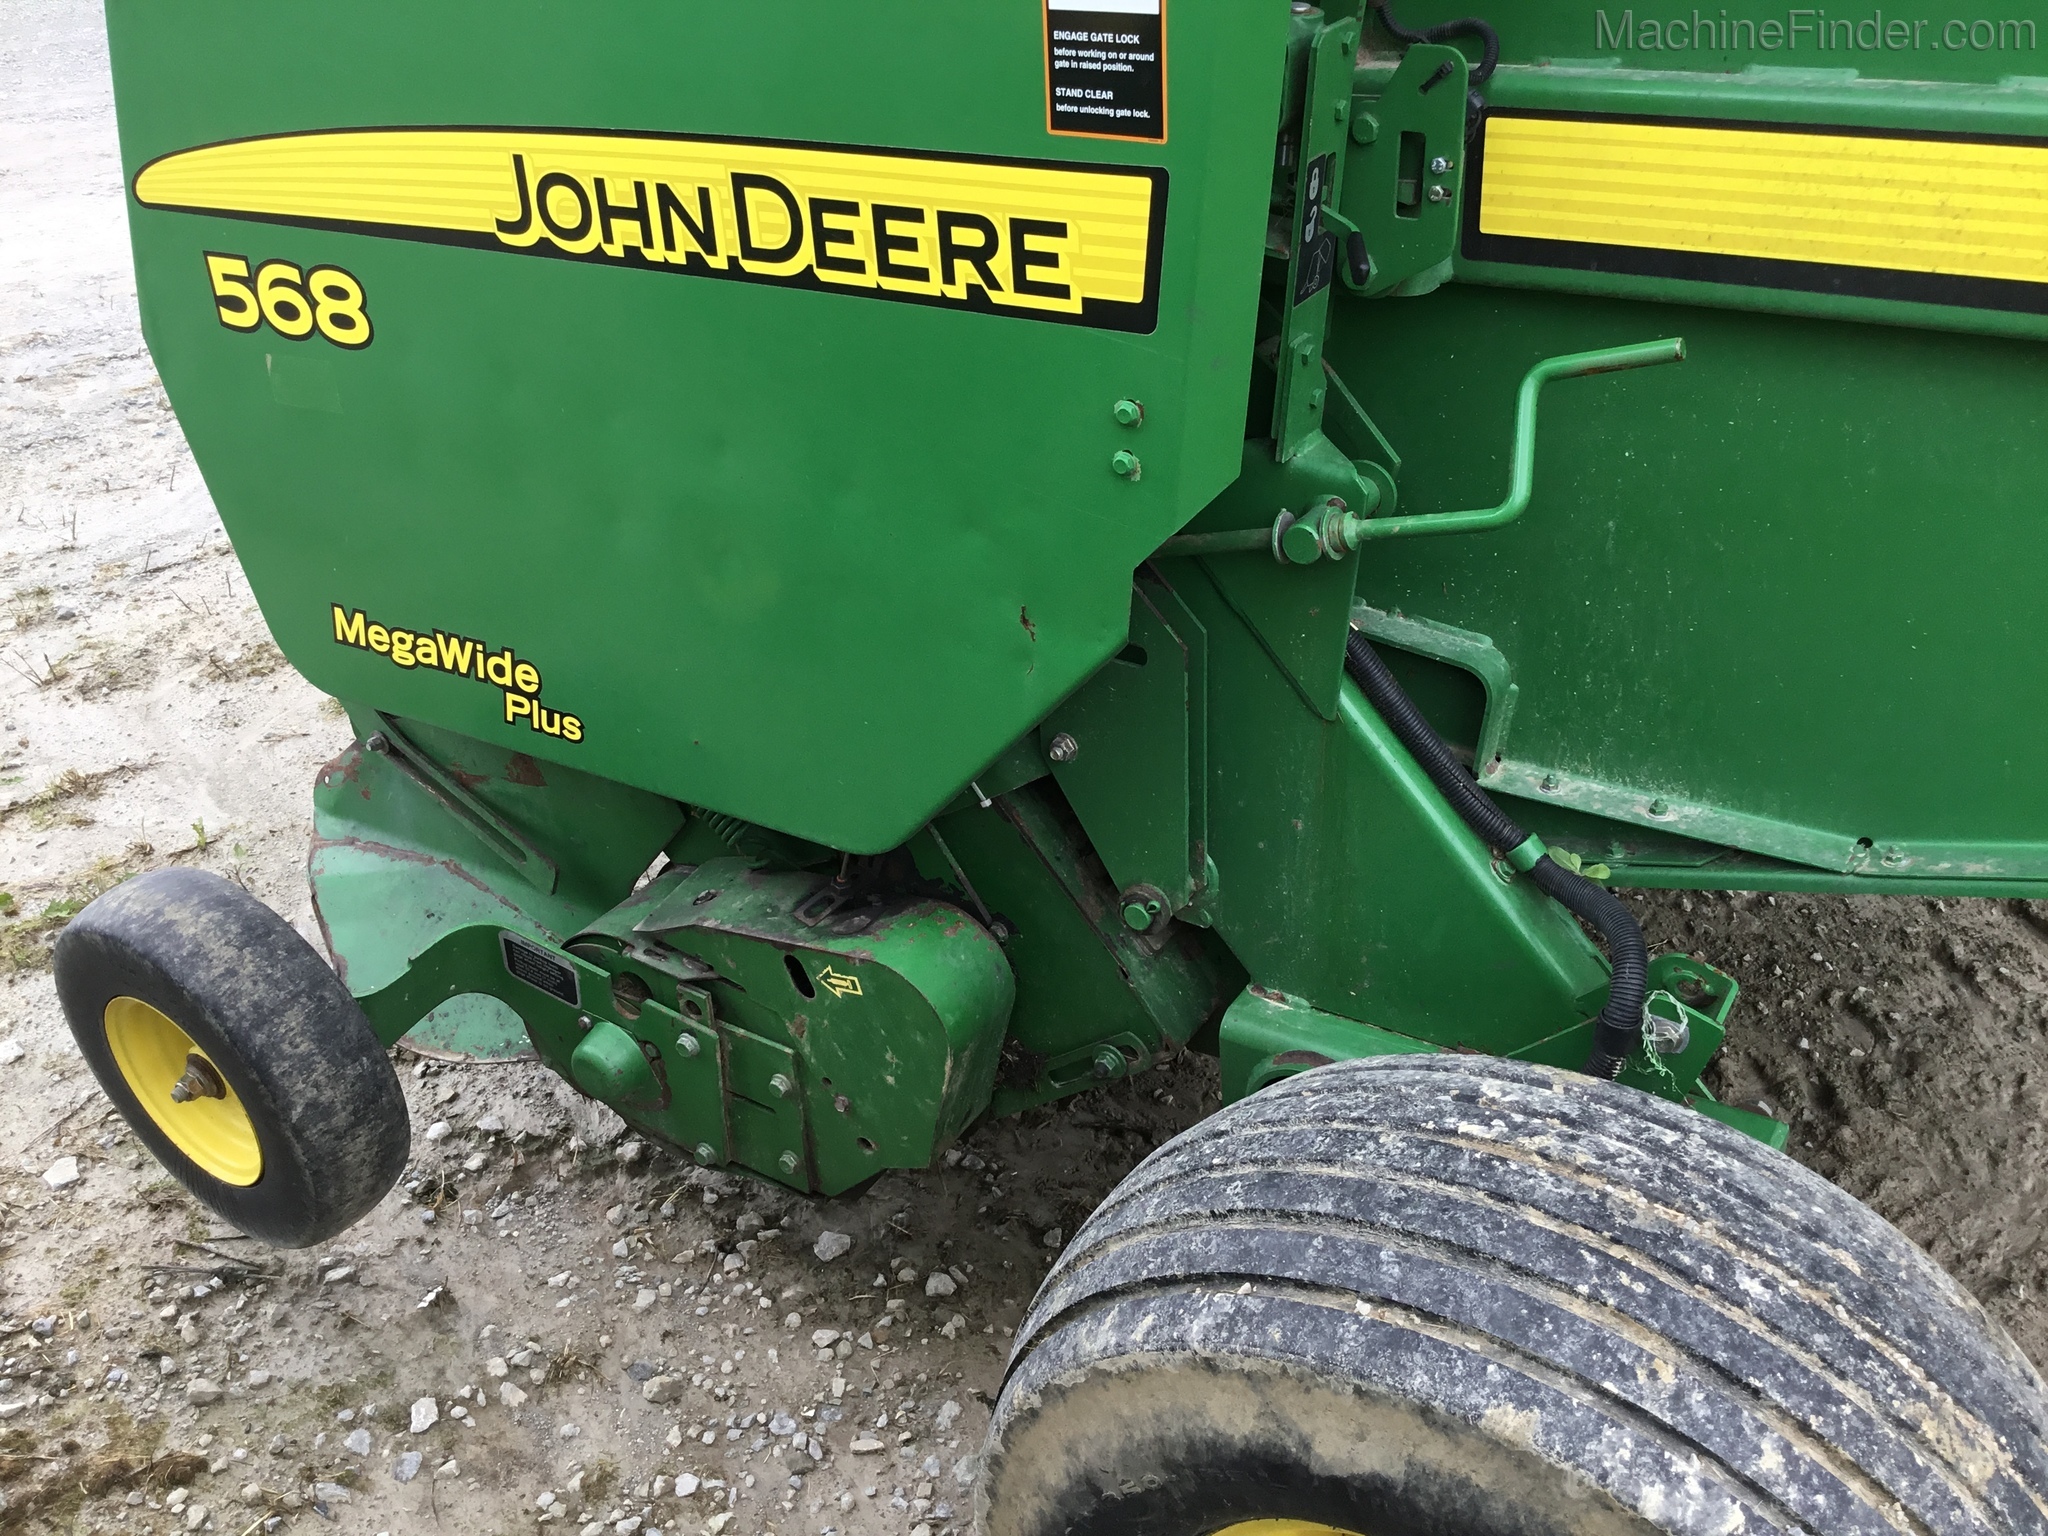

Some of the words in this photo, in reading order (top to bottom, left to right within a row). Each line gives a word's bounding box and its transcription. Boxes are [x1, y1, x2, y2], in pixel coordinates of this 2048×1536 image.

[1053, 30, 1089, 42] ENGAGE
[1090, 32, 1114, 43] GATE
[1115, 33, 1140, 45] LOCK
[1053, 46, 1077, 57] before
[1077, 48, 1106, 60] working
[1107, 51, 1118, 60] on
[1118, 52, 1127, 60] or
[1128, 52, 1155, 62] around
[1054, 60, 1069, 70] gate
[1070, 59, 1078, 69] in
[1079, 60, 1102, 70] raised
[1102, 62, 1135, 73] position.
[1055, 86, 1083, 98] STAND
[1084, 88, 1114, 100] CLEAR
[1055, 102, 1079, 113] before
[1079, 104, 1114, 118] unlocking
[1115, 108, 1132, 119] gate
[1132, 108, 1151, 119] lock.
[494, 151, 724, 266] JOHN
[730, 171, 1079, 310] DEERE
[203, 251, 374, 350] 568
[331, 603, 542, 697] MegaWide
[503, 690, 584, 743] Plus
[520, 939, 556, 961] IMPORTANT
